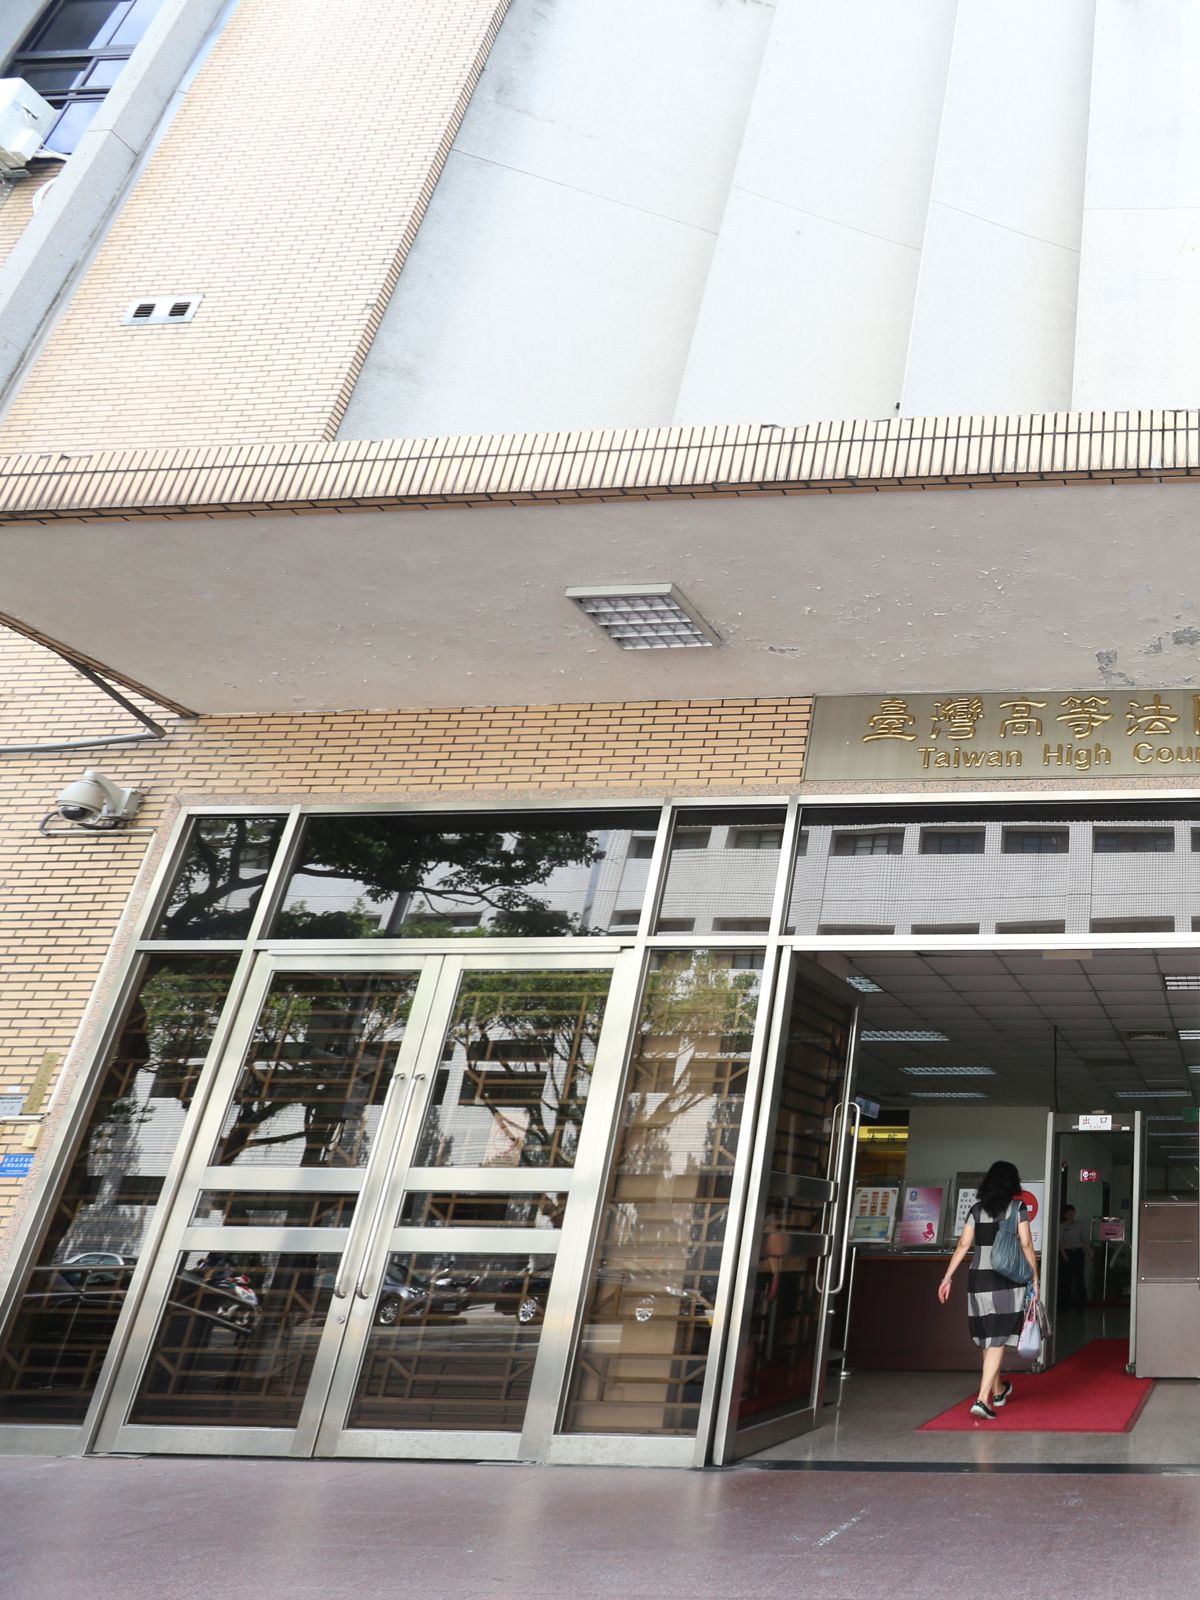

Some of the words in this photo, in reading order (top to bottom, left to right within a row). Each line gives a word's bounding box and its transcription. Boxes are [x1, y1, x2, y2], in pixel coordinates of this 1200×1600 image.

[917, 745, 1023, 770] Taiwan
[1042, 743, 1111, 772] High
[1082, 1116, 1108, 1124] 出口
